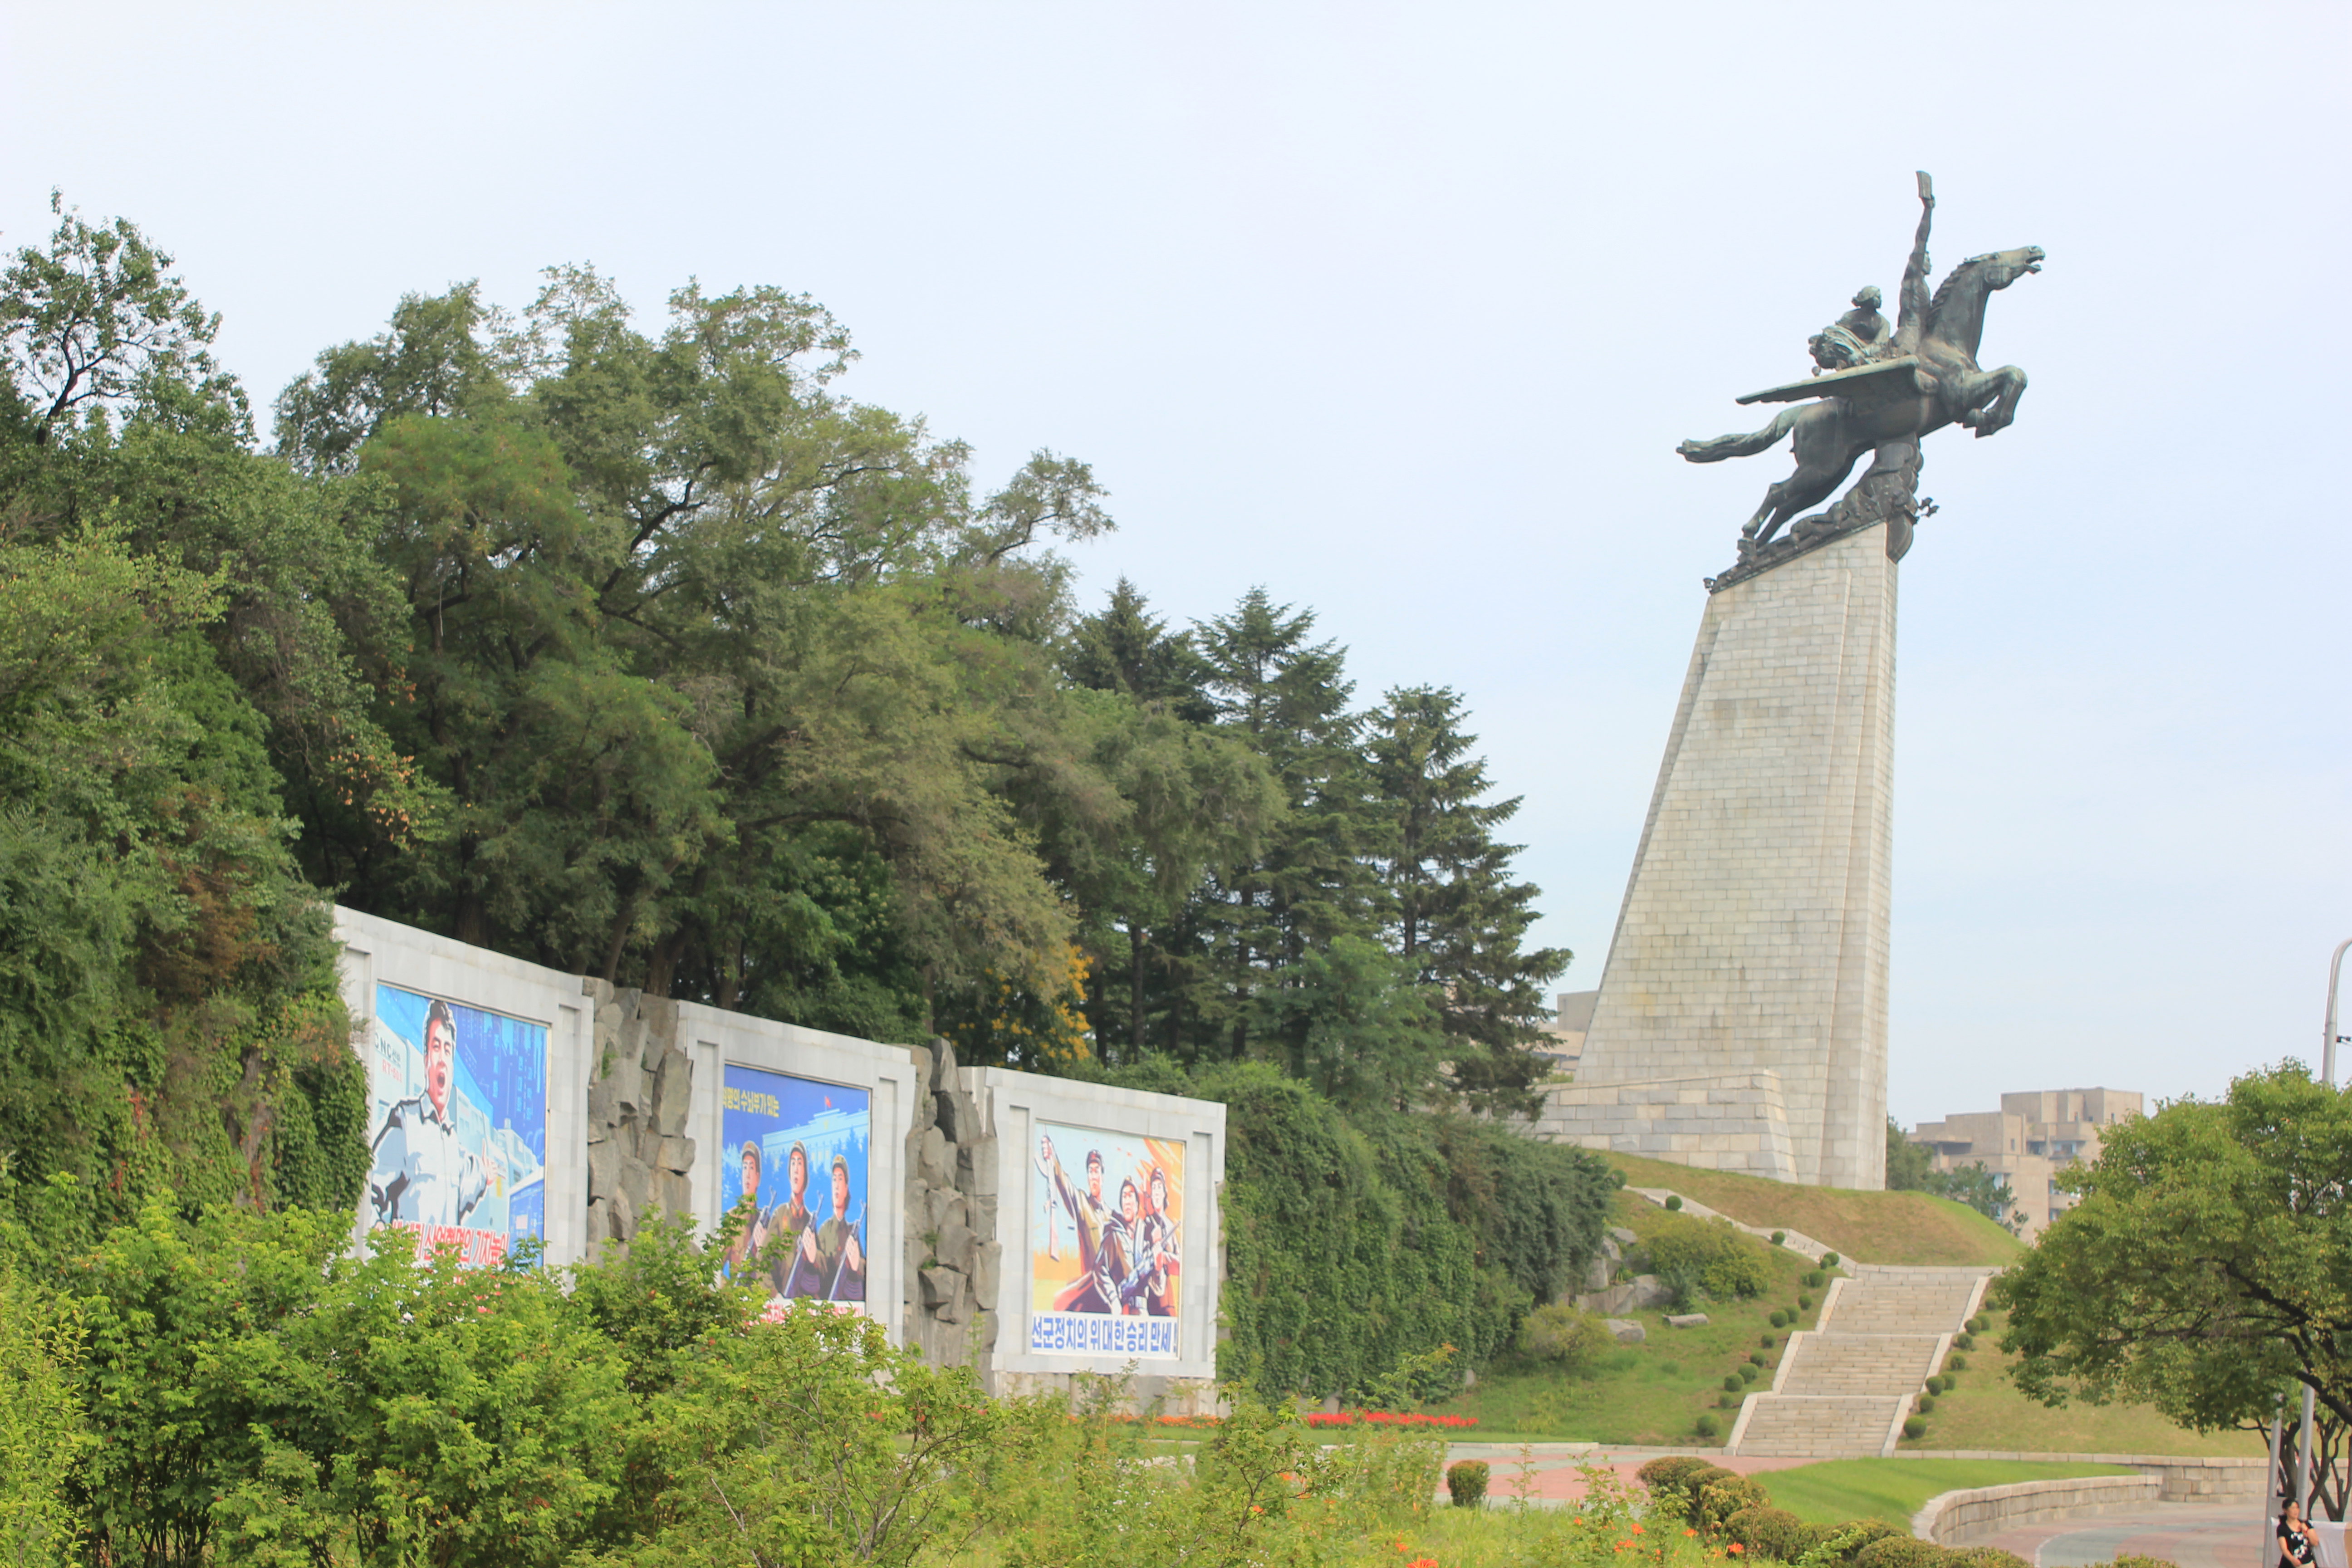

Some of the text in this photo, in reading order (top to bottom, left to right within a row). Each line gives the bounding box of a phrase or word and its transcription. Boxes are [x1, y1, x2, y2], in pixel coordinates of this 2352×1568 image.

[741, 1089, 766, 1115] 수뇌부가
[767, 1094, 779, 1118] 있는
[1032, 1317, 1087, 1349] 선군정치의
[1151, 1322, 1177, 1353] 만세!
